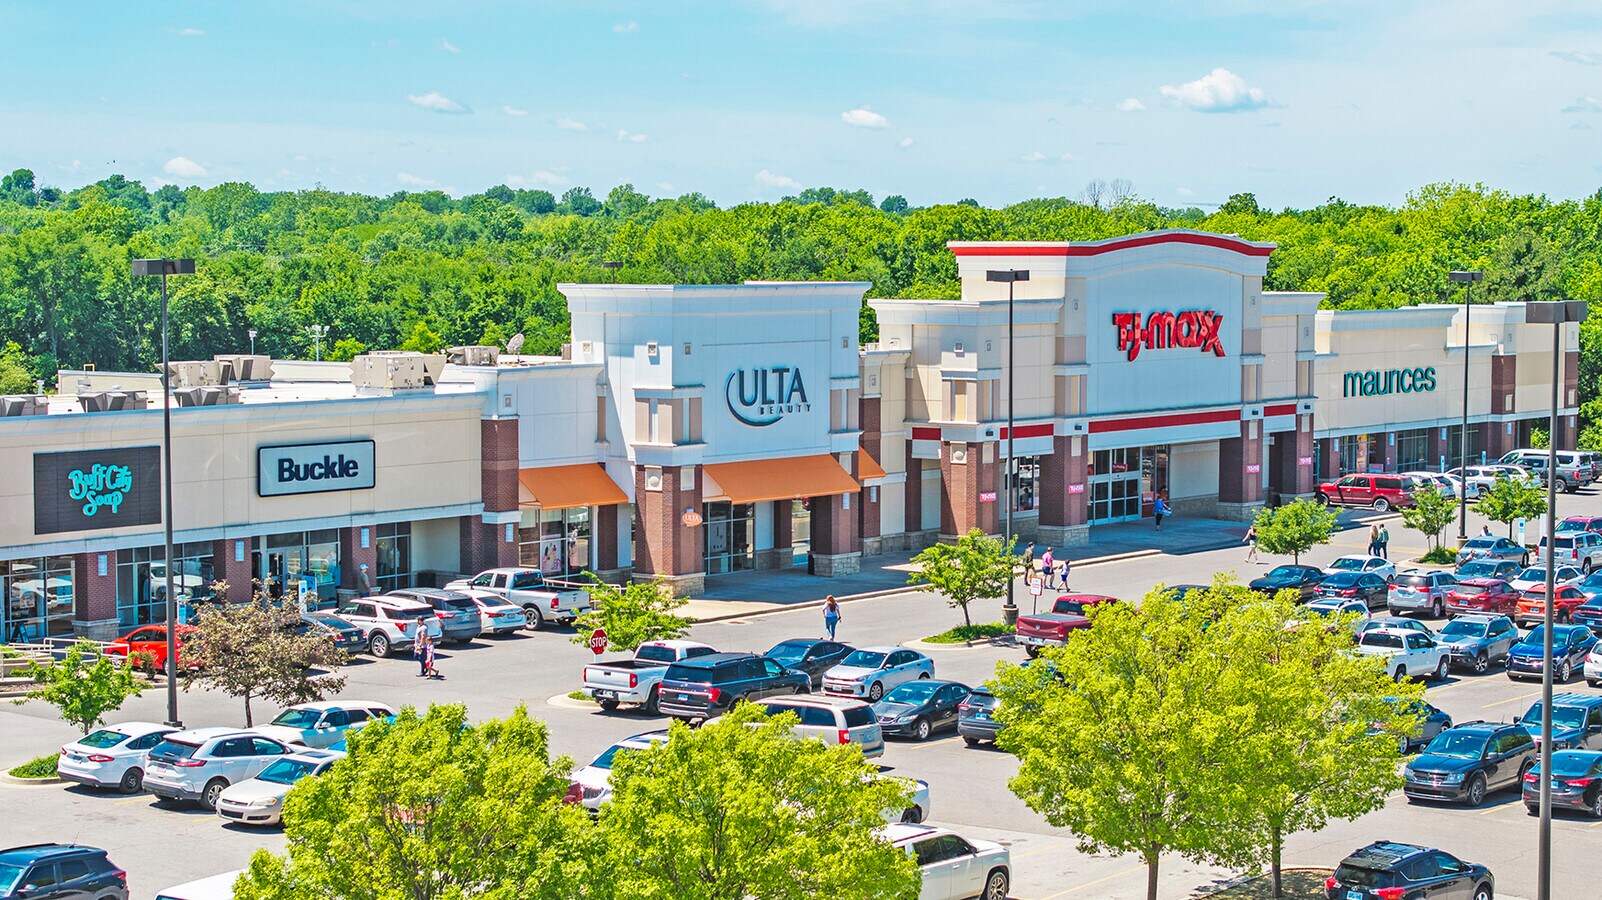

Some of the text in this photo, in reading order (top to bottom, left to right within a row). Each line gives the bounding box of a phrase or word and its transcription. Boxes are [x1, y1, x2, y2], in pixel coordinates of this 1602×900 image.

[738, 367, 807, 407] ULTA
[760, 404, 811, 415] BEAUTY
[68, 463, 132, 500] Buff City
[278, 454, 358, 482] Buckle
[82, 490, 123, 516] Soap
[591, 636, 606, 648] STOP
